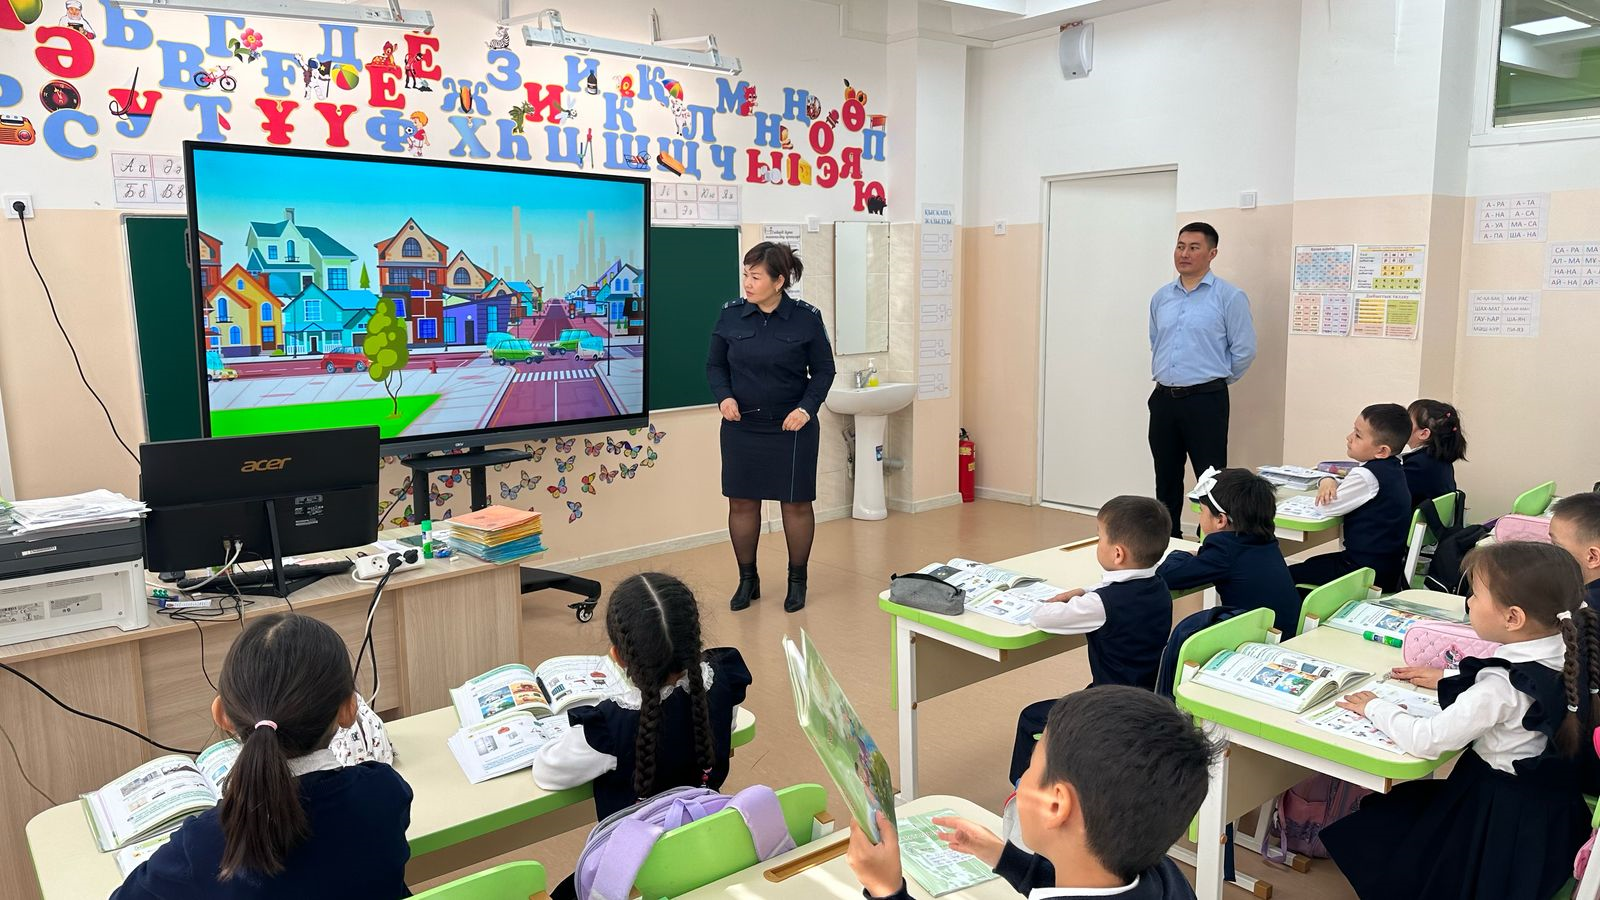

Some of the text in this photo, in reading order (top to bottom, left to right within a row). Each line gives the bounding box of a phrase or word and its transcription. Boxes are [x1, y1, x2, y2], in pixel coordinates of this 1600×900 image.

[99, 0, 153, 50] Б
[205, 15, 245, 57] Г
[35, 26, 95, 79] Ә
[157, 41, 204, 91] В
[316, 23, 363, 71] Д
[261, 50, 301, 96] Ғ
[365, 63, 406, 109] Е
[487, 49, 522, 91] З
[109, 88, 163, 138] У
[184, 94, 231, 141] Т
[441, 77, 491, 116] Ж
[603, 92, 637, 132] К
[716, 78, 750, 115] М
[783, 87, 810, 127] Ң
[842, 98, 866, 132] Ө
[43, 109, 98, 159] С
[255, 98, 300, 145] Ұ
[314, 102, 358, 147] Ү
[366, 109, 416, 152] Ф
[448, 116, 490, 158] Х
[682, 105, 716, 142] Л
[754, 111, 783, 148] Н
[809, 120, 834, 155] О
[545, 126, 583, 168] Ц
[604, 132, 651, 171] Ш
[656, 138, 701, 180] Щ
[710, 144, 737, 180] Ч
[840, 147, 863, 179] Я
[862, 128, 886, 161] П
[816, 155, 839, 189] Э
[853, 180, 886, 212] Ю
[241, 457, 292, 473] acer
